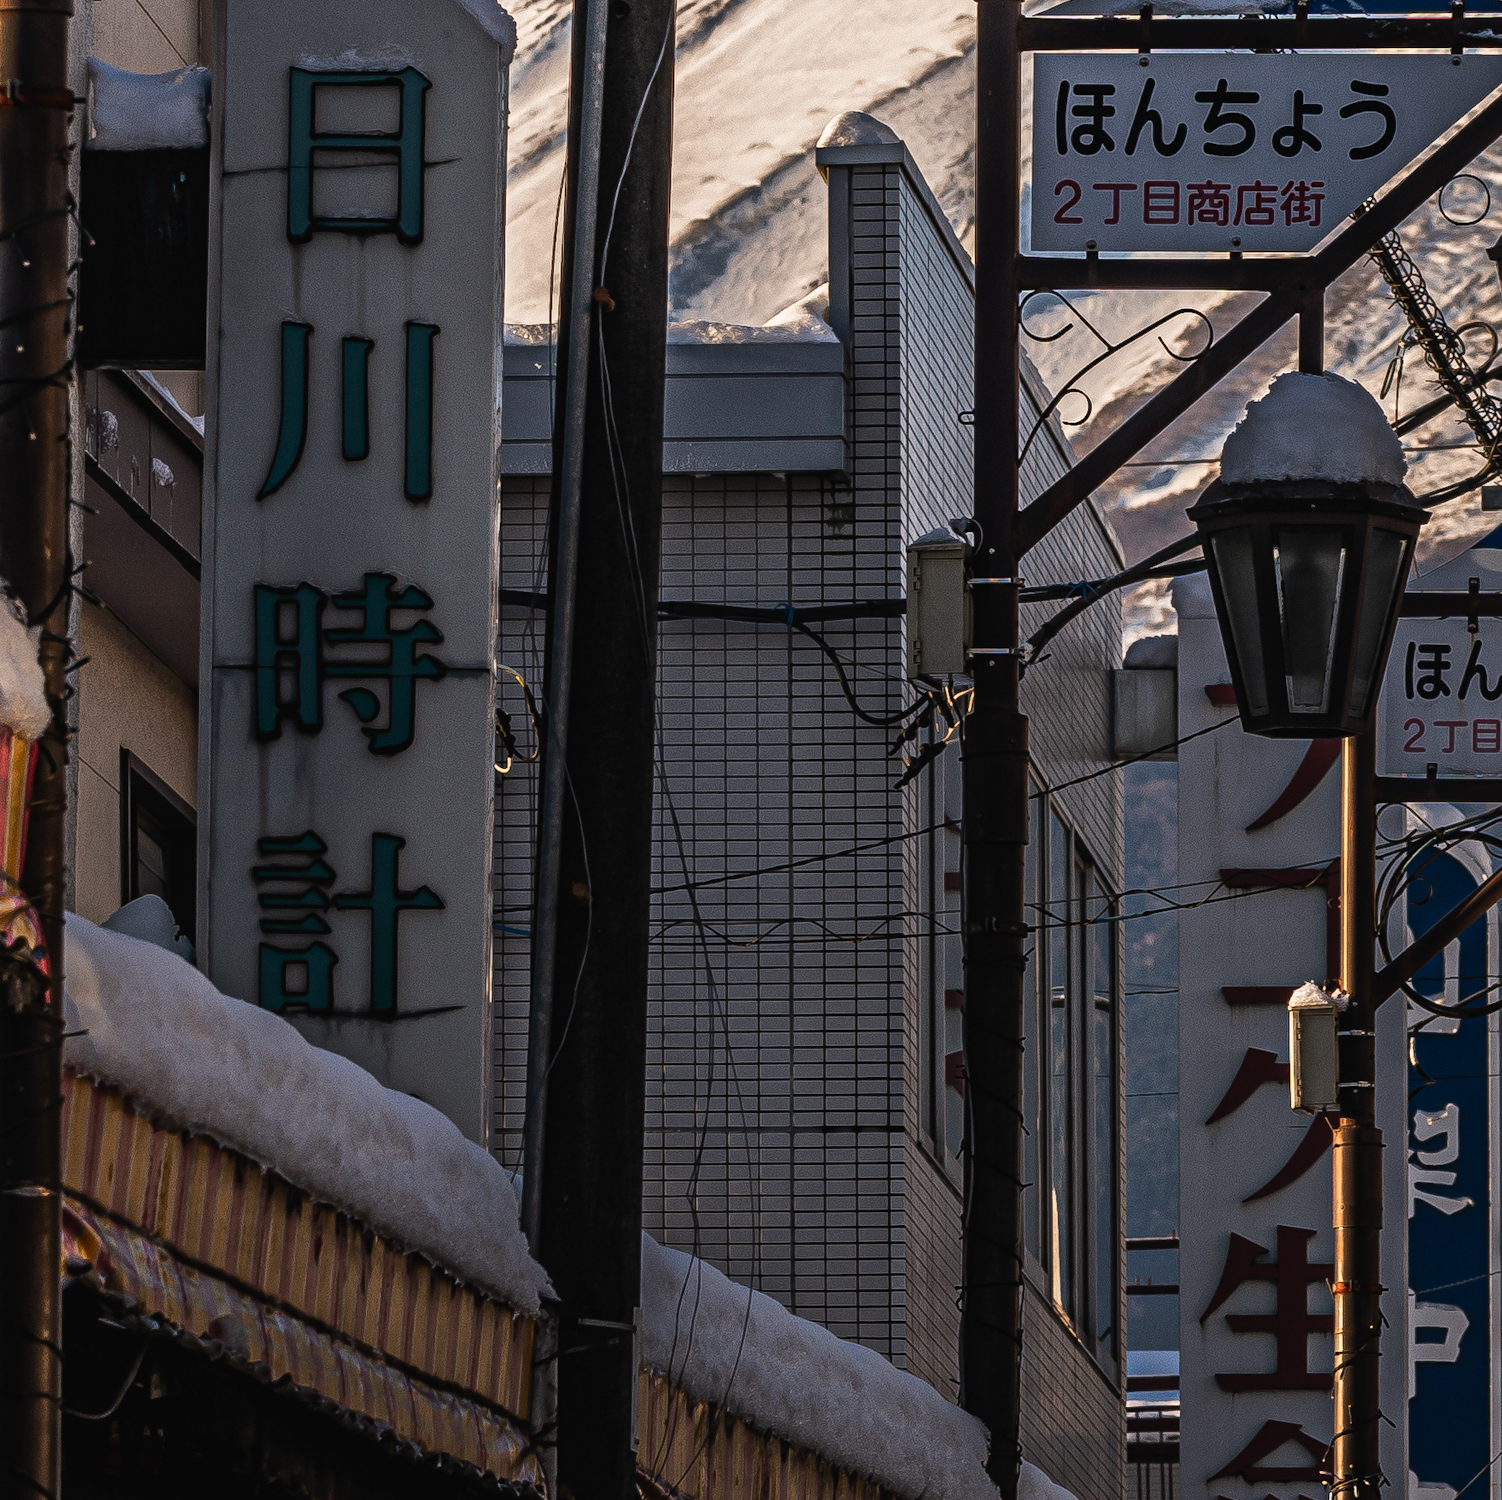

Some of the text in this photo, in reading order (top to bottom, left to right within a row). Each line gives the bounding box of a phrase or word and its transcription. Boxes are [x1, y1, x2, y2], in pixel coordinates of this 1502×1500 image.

[1055, 78, 1397, 160] ほんちょう
[1053, 179, 1326, 227] 2丁目商店街
[254, 66, 446, 1020] 日川時計
